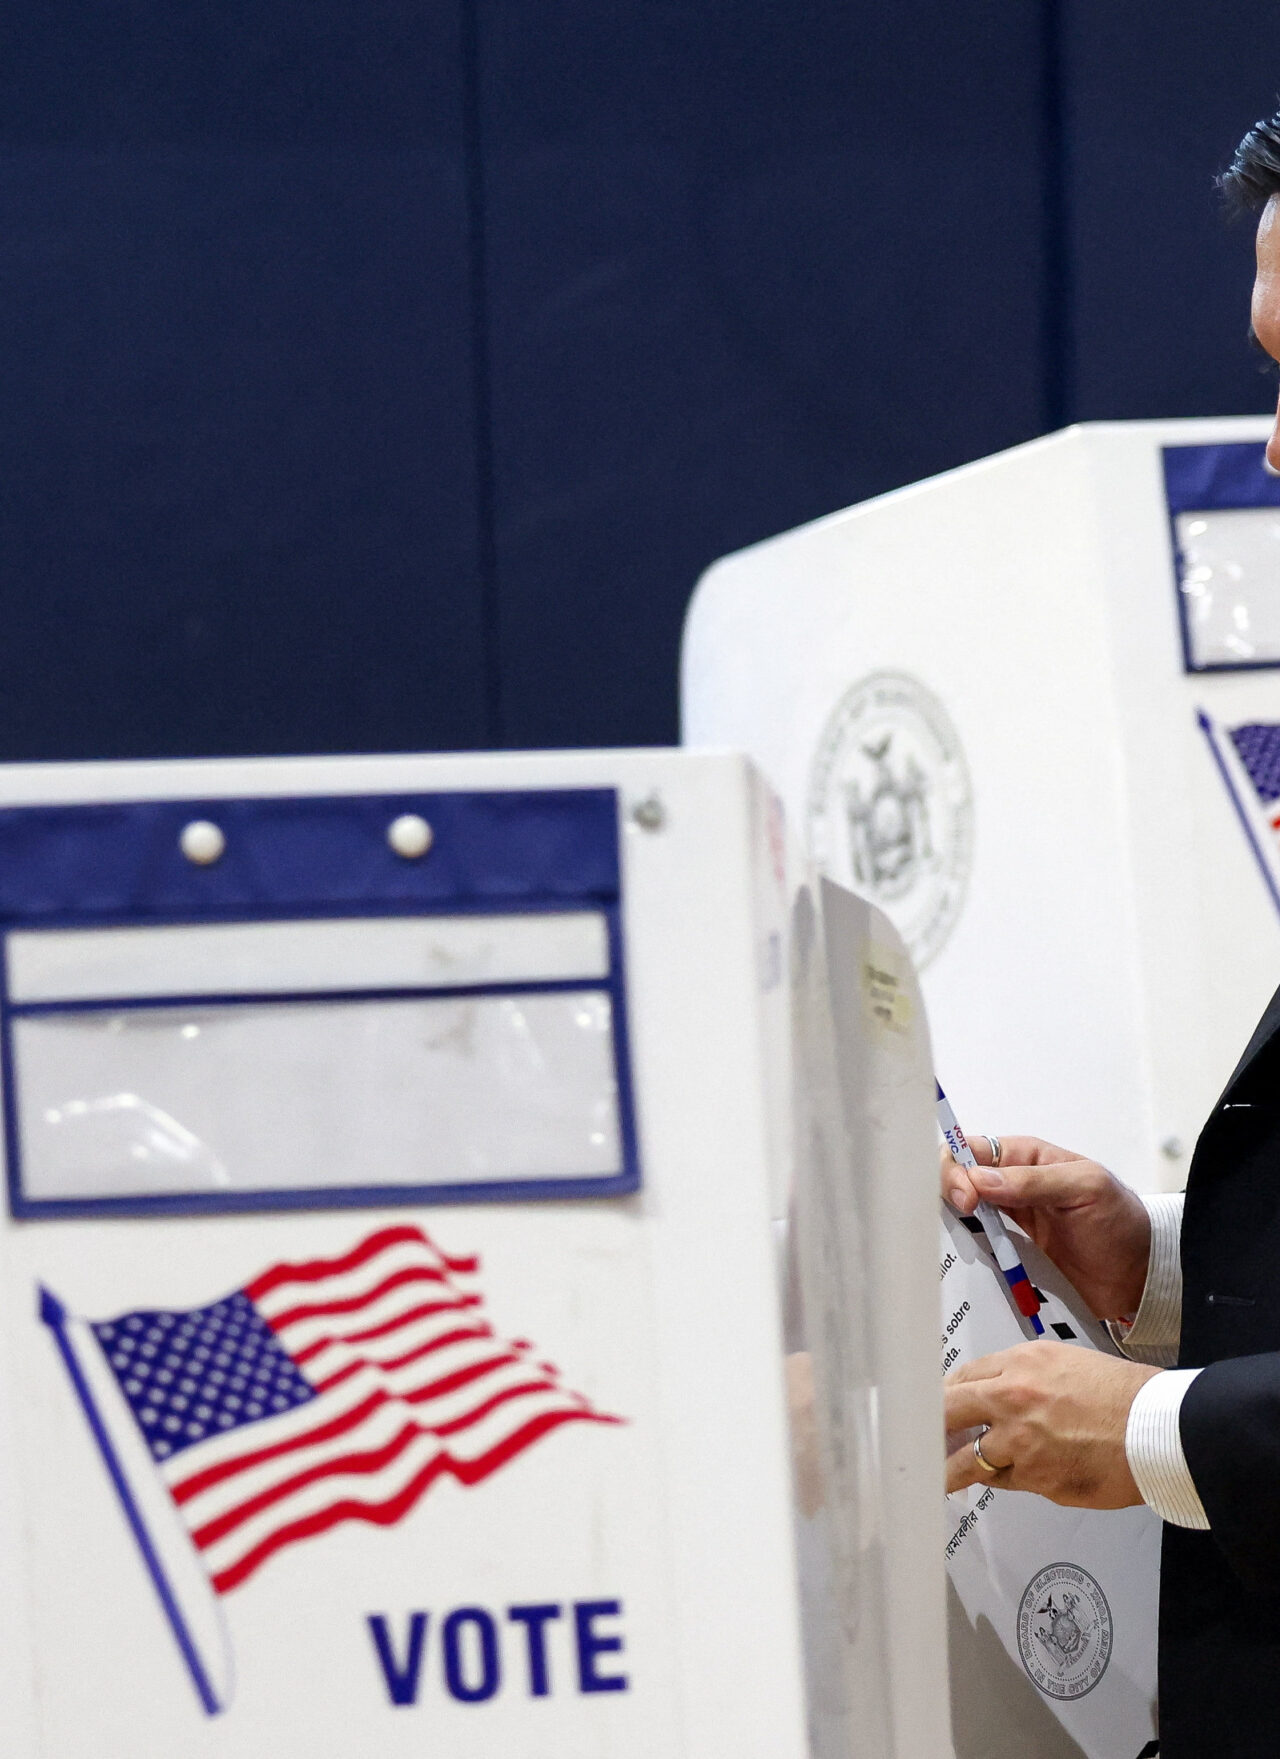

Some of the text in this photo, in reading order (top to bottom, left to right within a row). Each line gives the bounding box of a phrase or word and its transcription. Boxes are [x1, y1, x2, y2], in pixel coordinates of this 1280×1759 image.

[944, 1130, 959, 1154] NYC
[953, 1125, 968, 1149] VOTE
[940, 1253, 957, 1281] llot.
[946, 1301, 971, 1335] sobre
[945, 1510, 979, 1560] য়মাবলীর
[1021, 1568, 1084, 1660] BOARD OF ELECTIONS
[1090, 1588, 1108, 1625] YORK
[366, 1600, 629, 1706] VOTE
[1099, 1628, 1109, 1659] NEW
[1034, 1668, 1046, 1684] IN
[1090, 1660, 1101, 1678] OF
[1047, 1678, 1065, 1694] THE
[1068, 1675, 1089, 1694] CITY
